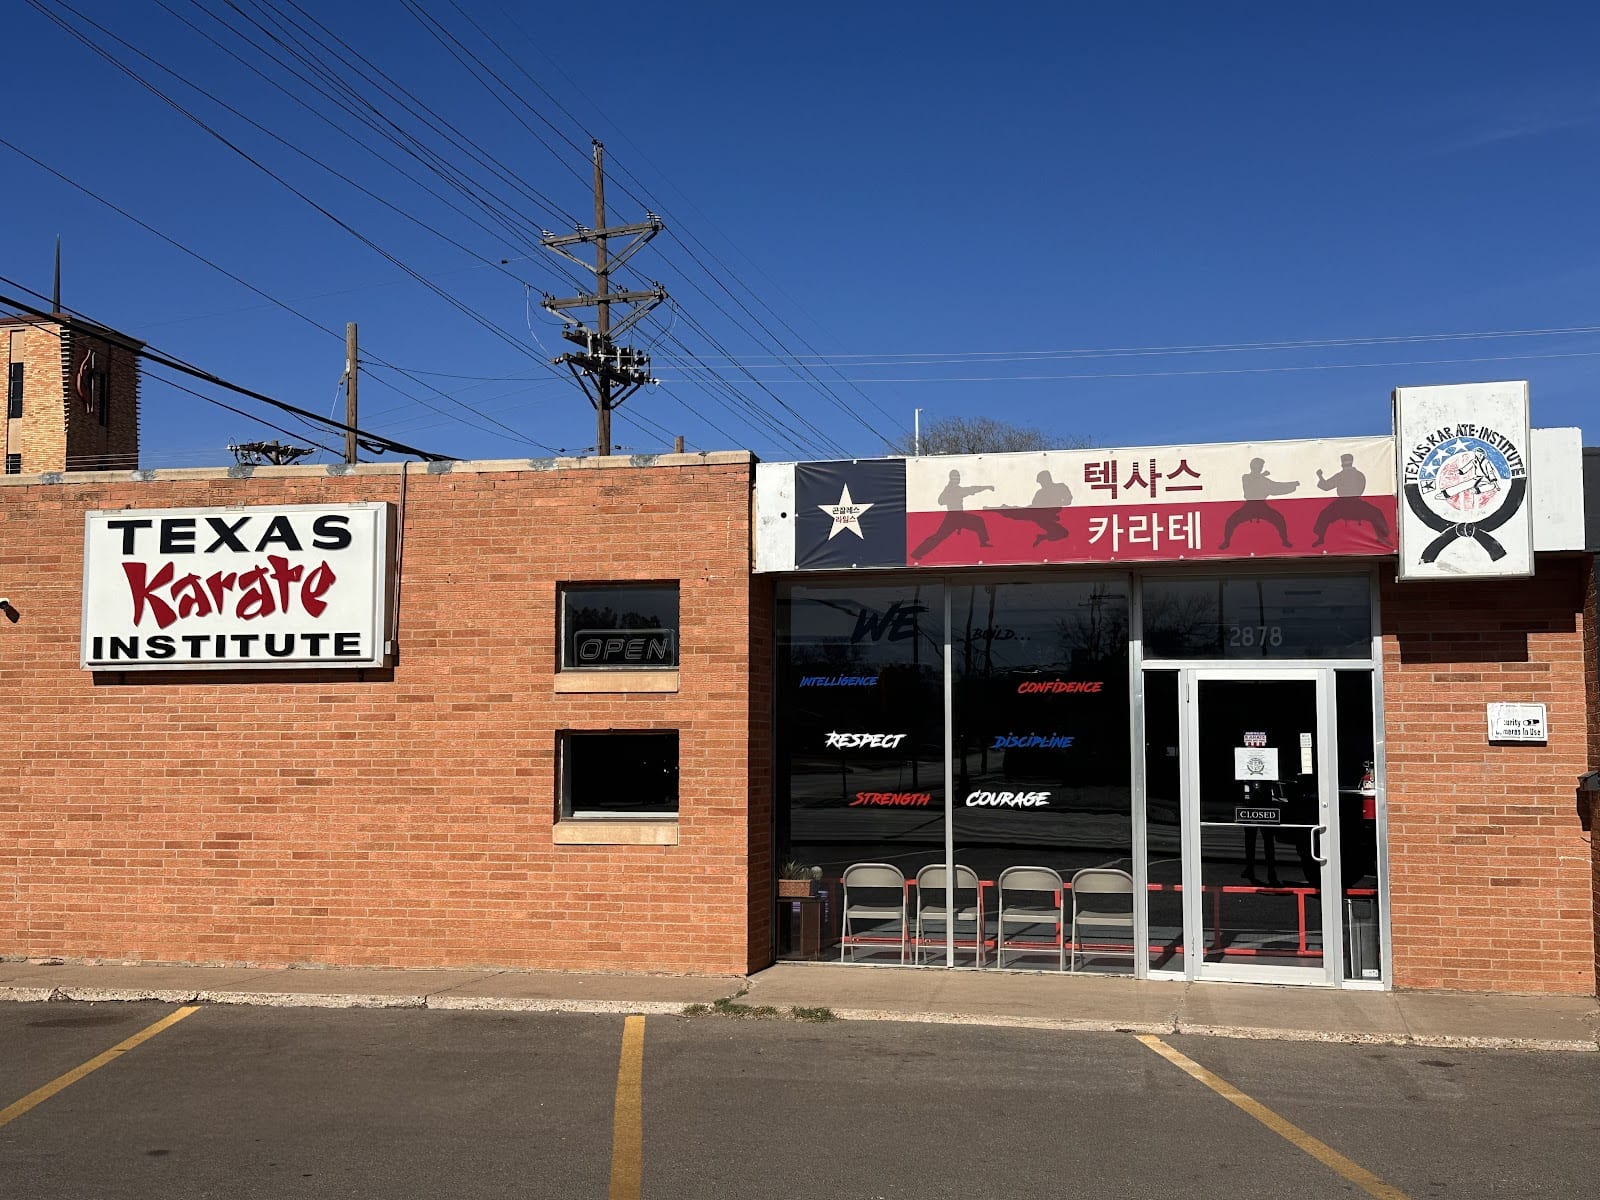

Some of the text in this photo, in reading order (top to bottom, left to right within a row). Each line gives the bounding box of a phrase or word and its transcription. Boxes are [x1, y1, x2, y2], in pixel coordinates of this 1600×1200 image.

[1083, 458, 1203, 500] 텍사스
[107, 515, 353, 555] TEXAS
[1088, 511, 1202, 553] 카라테
[121, 554, 337, 629] Karate
[851, 598, 929, 644] WE
[92, 632, 361, 660] INSTITUTE
[1229, 626, 1283, 647] 2878
[579, 638, 669, 661] OPEN
[799, 674, 880, 688] INTELLIGENCE
[1016, 678, 1104, 694] CONFIDENCE
[823, 730, 907, 750] RESPECT
[990, 731, 1076, 749] DISCIPLINE
[848, 791, 932, 807] STRENGTH
[965, 789, 1052, 807] COURAGE
[1239, 810, 1276, 819] CLOSED
